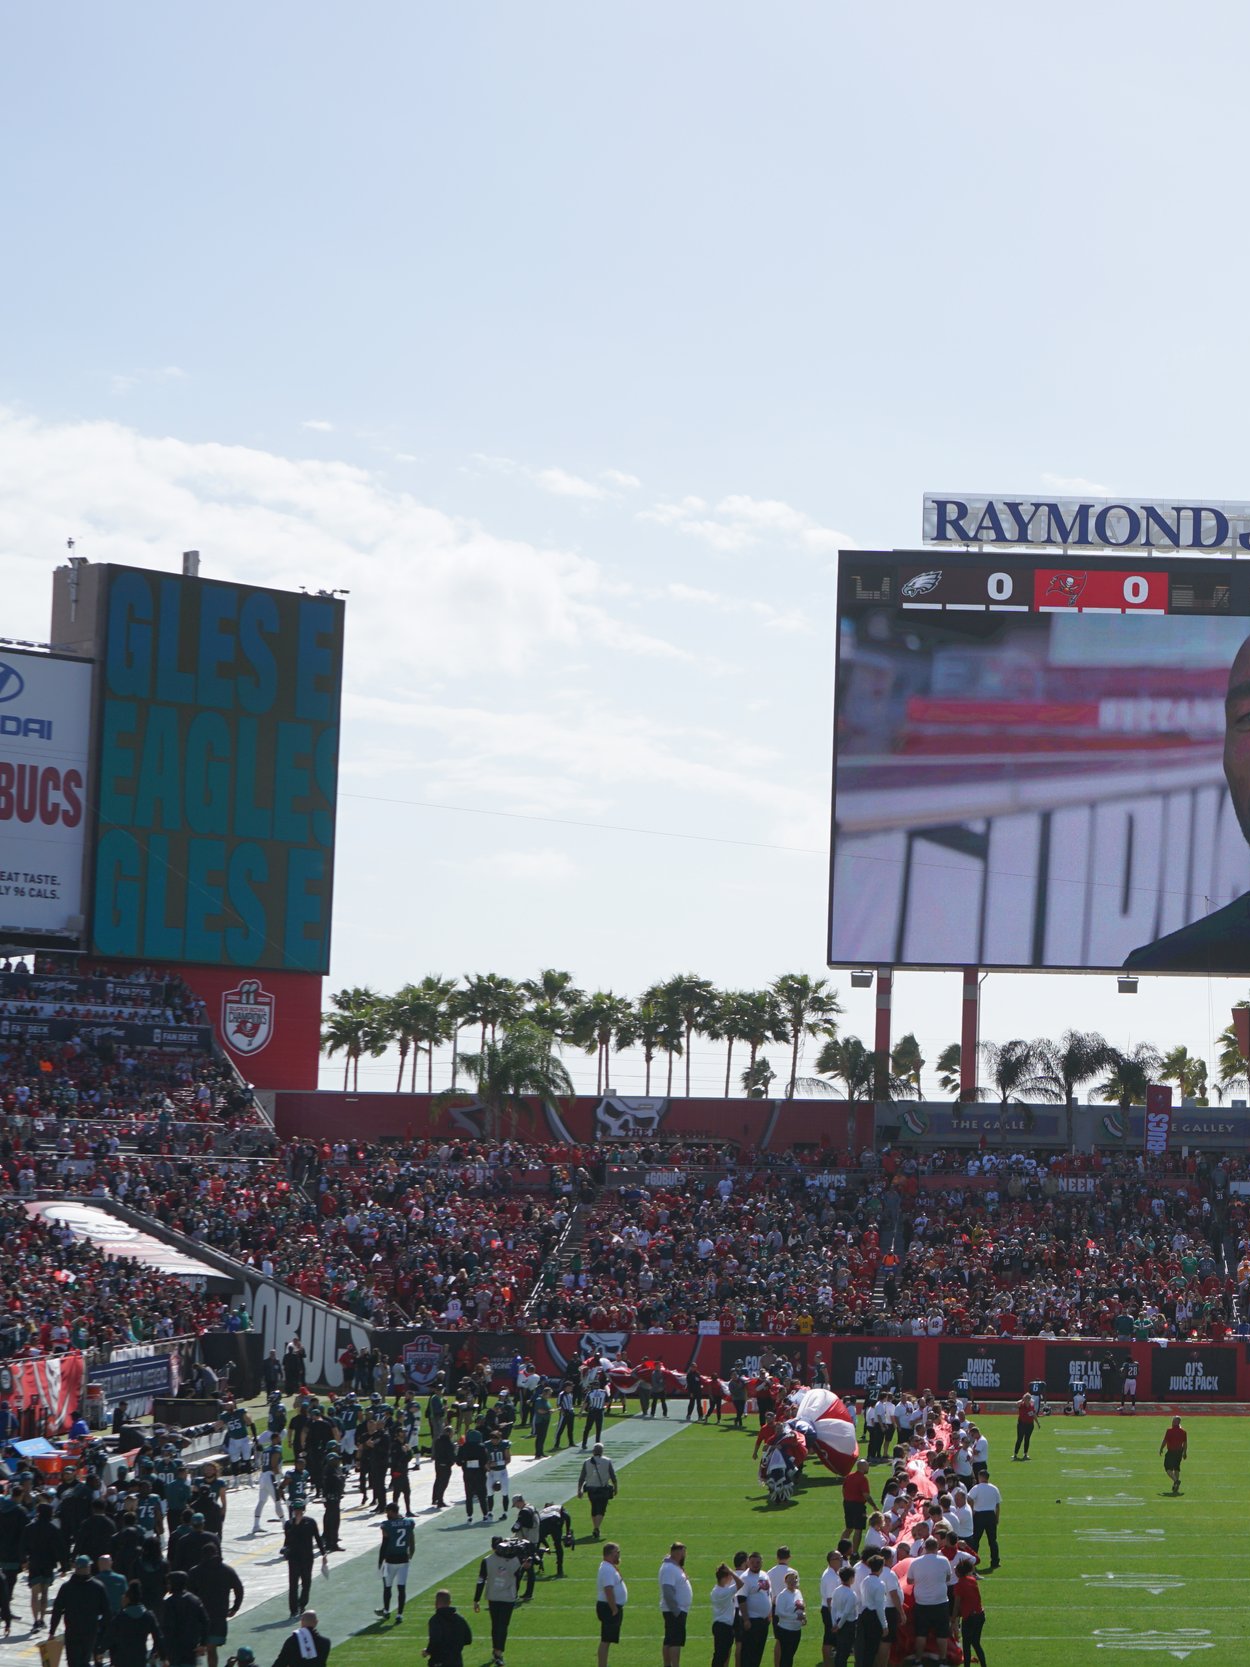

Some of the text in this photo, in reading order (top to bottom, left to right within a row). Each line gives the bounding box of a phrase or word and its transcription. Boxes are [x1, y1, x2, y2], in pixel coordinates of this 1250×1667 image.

[931, 499, 1229, 548] RAYMOND
[987, 572, 1013, 600] 0
[1123, 575, 1149, 603] 0
[107, 571, 279, 715] GLES
[0, 761, 83, 828] BUCS
[23, 873, 61, 885] TASTE.
[28, 887, 60, 900] CALS.
[93, 829, 269, 967] GLES
[951, 1119, 978, 1129] THE
[1181, 1123, 1234, 1133] GALLEY
[967, 1358, 996, 1374] DAVIS'
[1069, 1361, 1085, 1375] GET
[1185, 1362, 1204, 1377] OJ'S
[1169, 1376, 1219, 1392] JUICE PACK
[395, 1528, 406, 1547] 2
